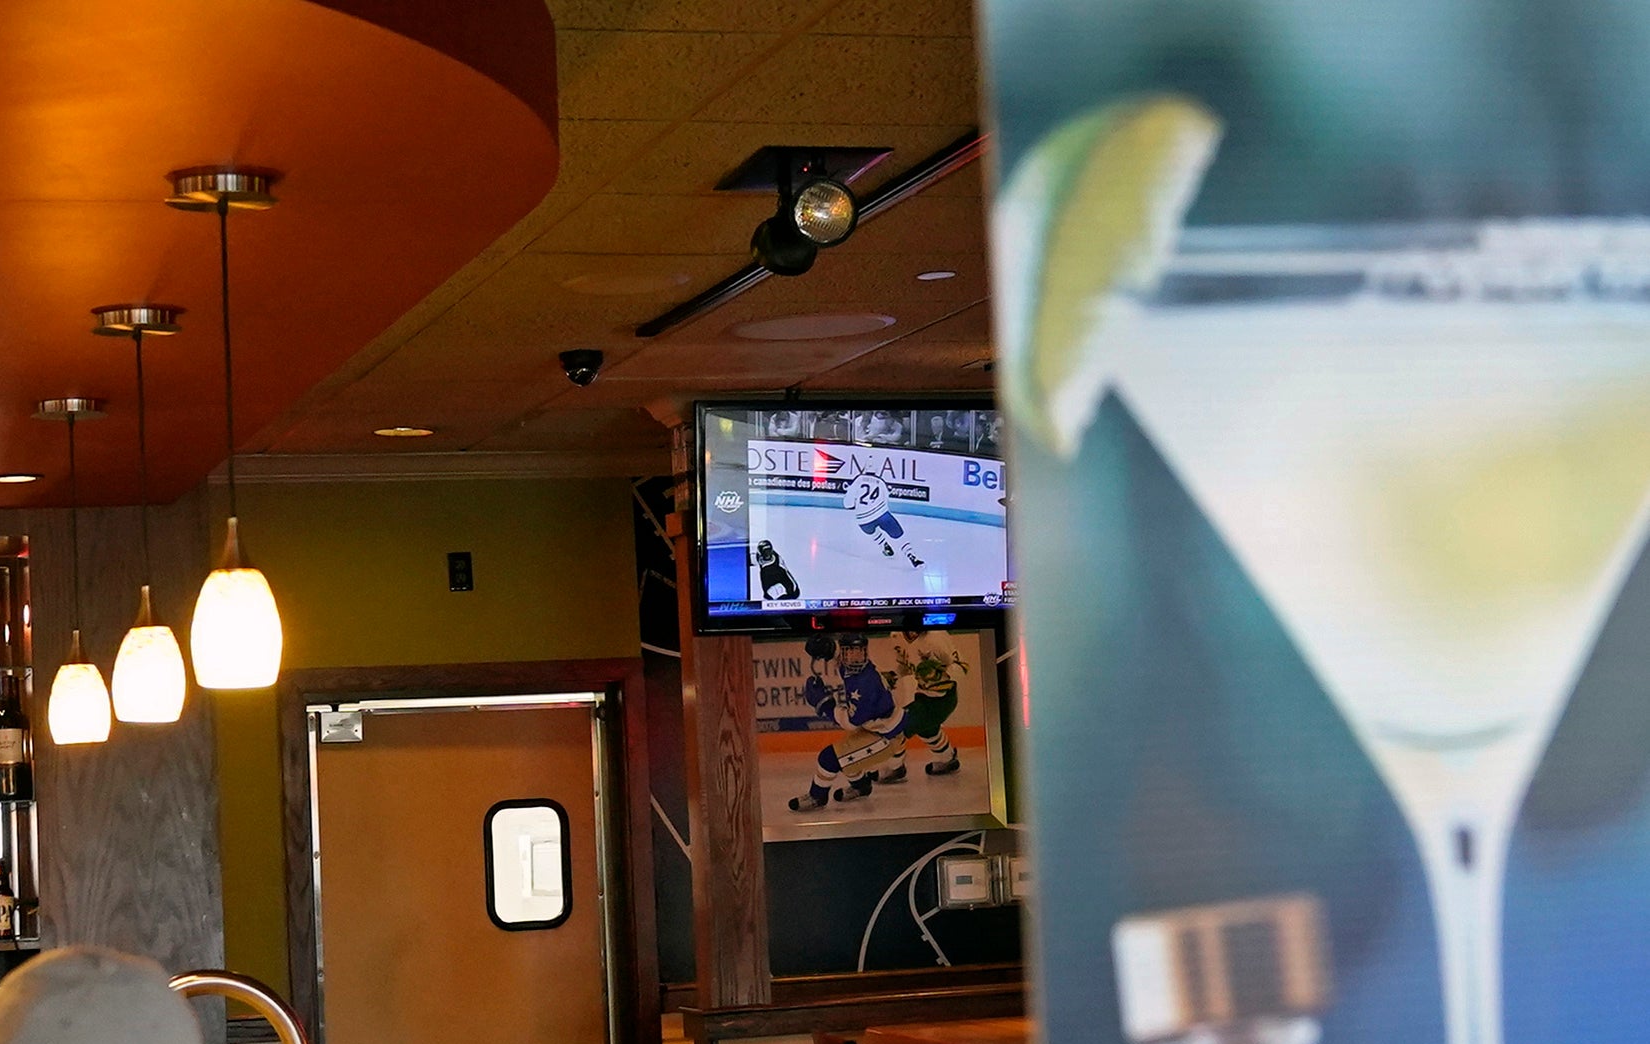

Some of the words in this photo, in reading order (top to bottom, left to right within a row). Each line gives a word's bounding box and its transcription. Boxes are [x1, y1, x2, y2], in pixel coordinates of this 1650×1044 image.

[797, 479, 810, 489] des
[811, 481, 836, 491] postes
[714, 496, 744, 506] NHL
[859, 483, 881, 505] 24
[752, 657, 803, 679] TWIN
